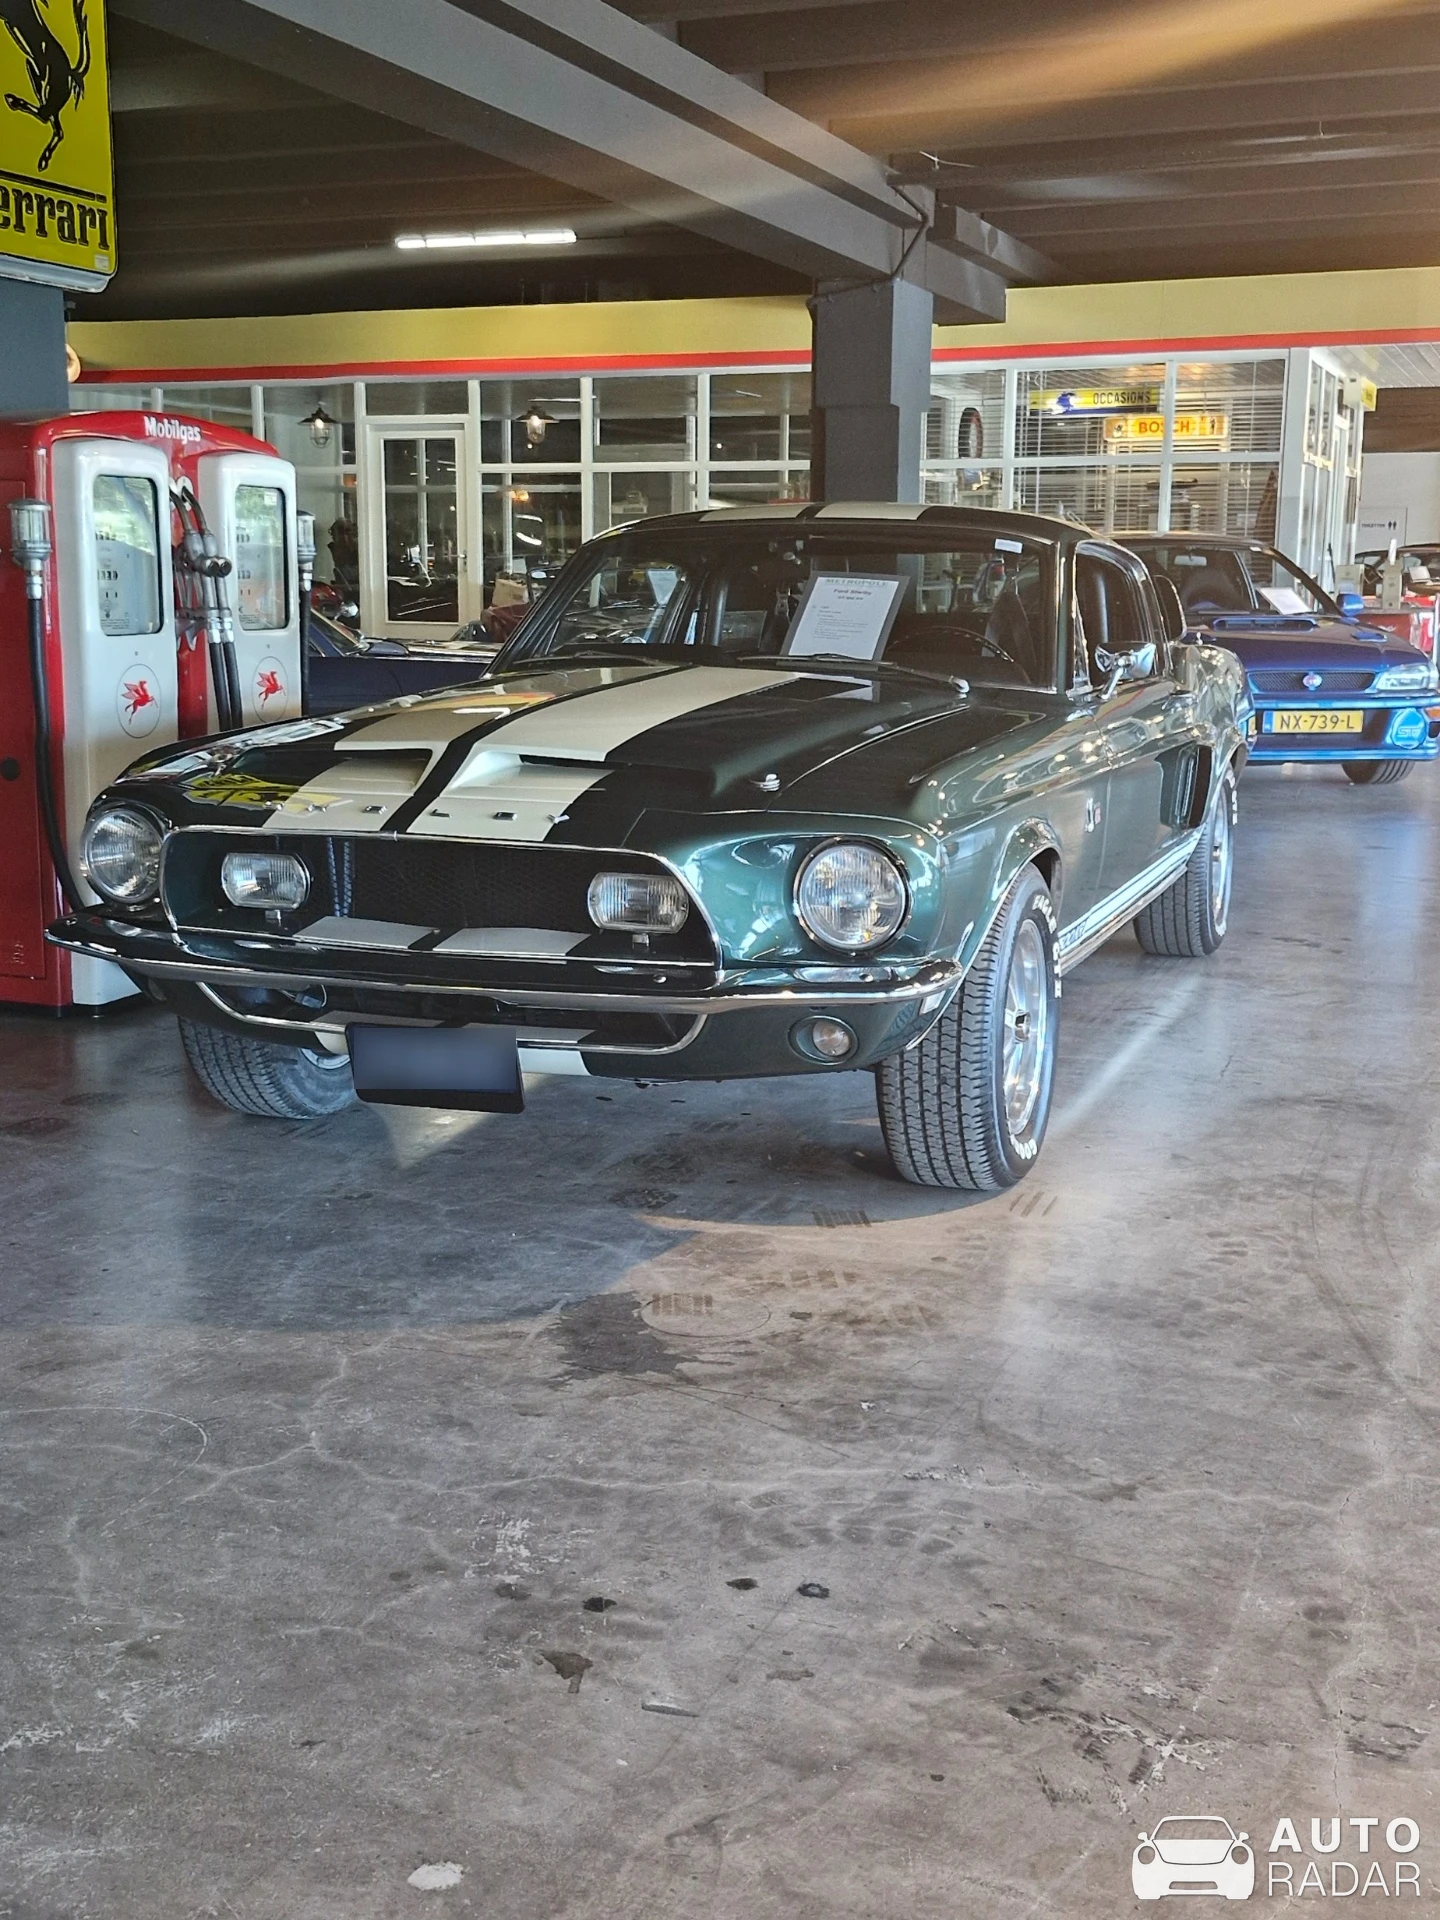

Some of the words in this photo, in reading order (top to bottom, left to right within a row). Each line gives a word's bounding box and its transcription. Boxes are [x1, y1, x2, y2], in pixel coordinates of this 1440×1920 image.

[1092, 391, 1151, 404] OCCASIONS
[143, 415, 201, 445] Mobilgas
[1138, 420, 1190, 434] BOCH
[1280, 714, 1355, 730] NX-739-L
